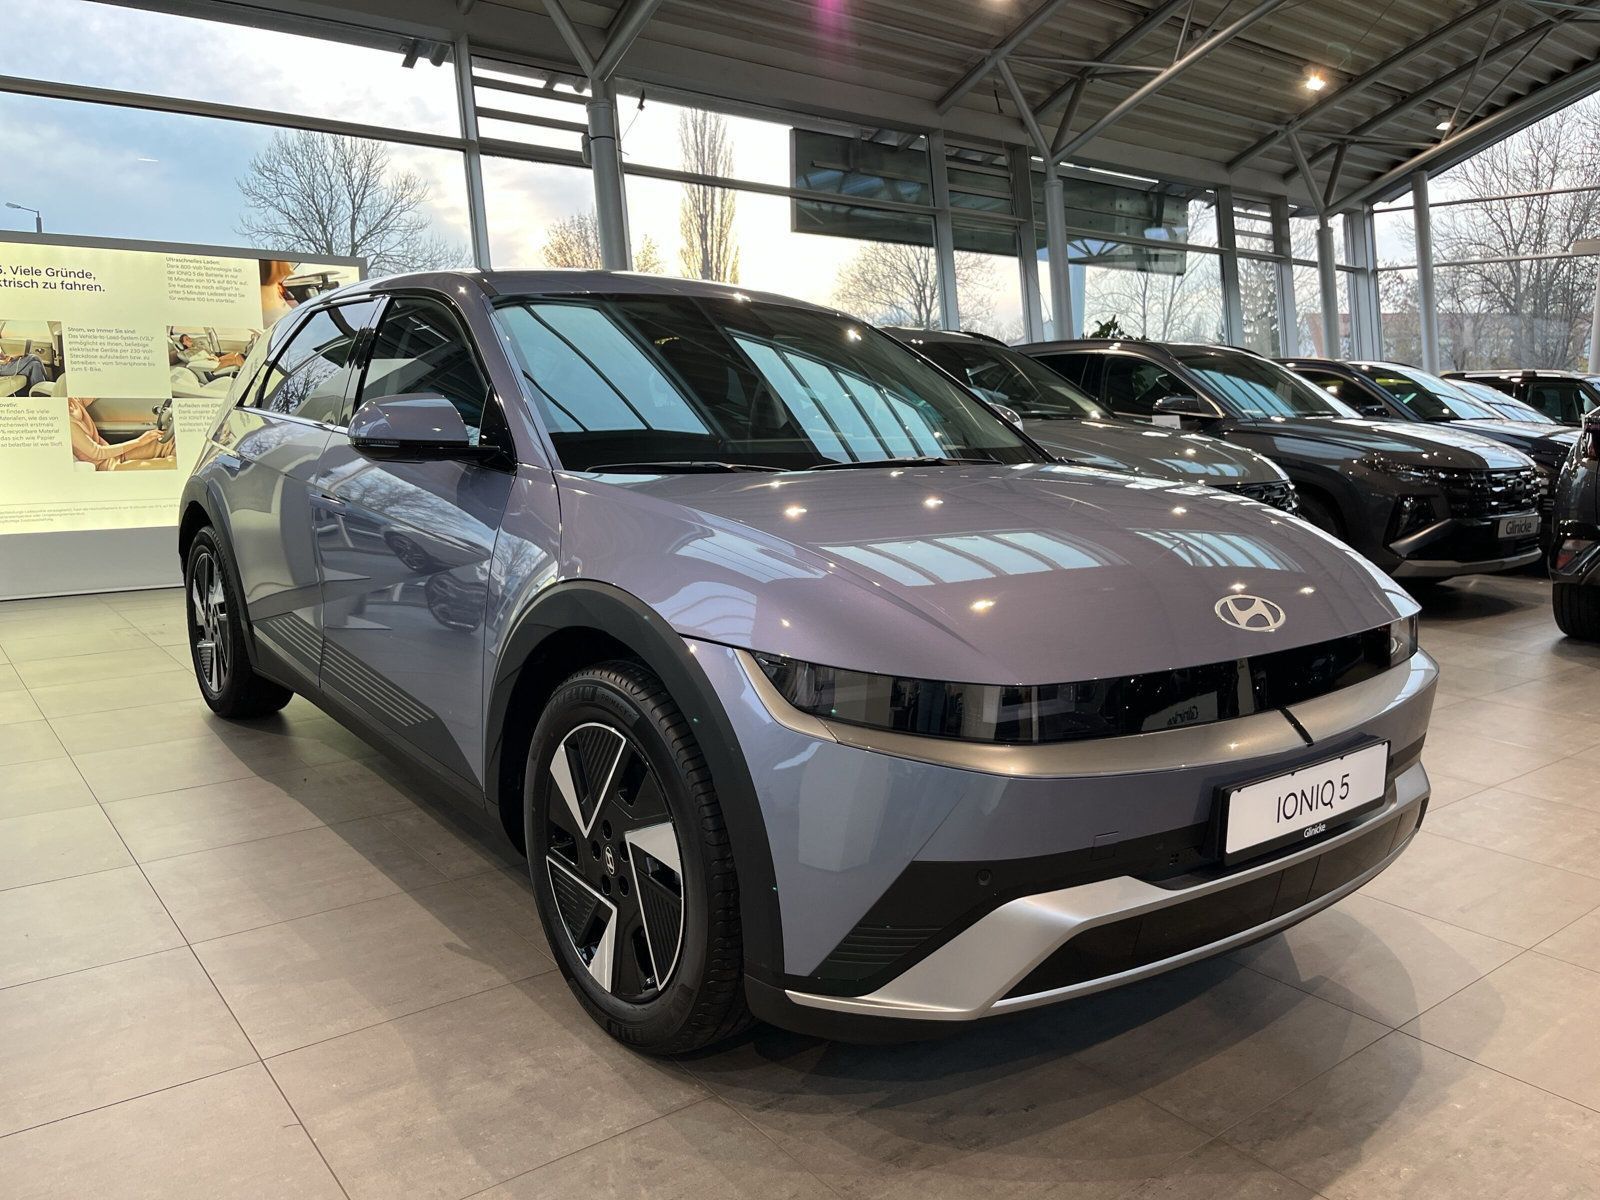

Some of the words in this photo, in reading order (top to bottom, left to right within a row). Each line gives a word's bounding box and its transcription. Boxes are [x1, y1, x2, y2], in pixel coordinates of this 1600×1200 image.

[10, 266, 42, 276] Viele
[46, 268, 96, 280] Gründe,
[42, 282, 56, 290] zu
[60, 280, 105, 292] fahren.
[1506, 520, 1532, 535] Glinicke
[1277, 780, 1334, 823] IONIQ
[1339, 773, 1350, 800] 5
[1304, 823, 1326, 838] Glinicke
